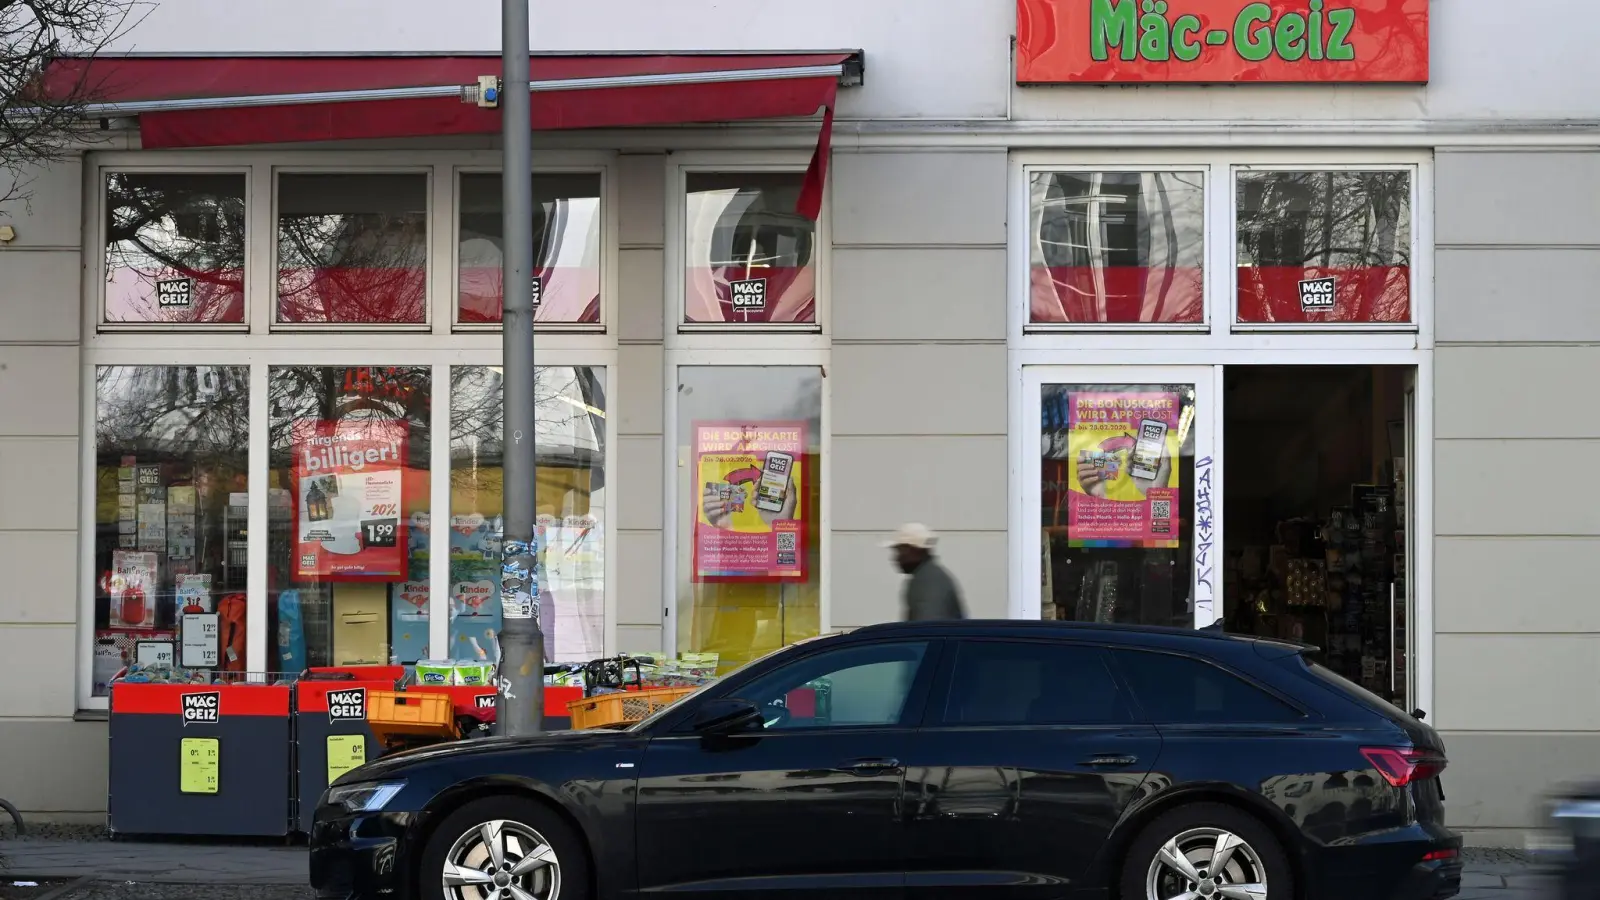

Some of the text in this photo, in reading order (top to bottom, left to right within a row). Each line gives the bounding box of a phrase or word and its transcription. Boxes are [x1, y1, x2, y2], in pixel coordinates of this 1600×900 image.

[1090, 0, 1356, 62] Mäc-Geiz
[160, 281, 189, 293] MÄC
[734, 282, 763, 294] MÄC
[1302, 282, 1333, 293] MÄC
[160, 293, 189, 305] GEIZ
[734, 294, 763, 305] GEIZ
[1302, 294, 1333, 305] GEIZ
[1077, 400, 1173, 408] DIE BONUSKARTE
[1076, 410, 1107, 419] WIRD
[306, 431, 362, 447] nirgends
[702, 432, 798, 440] DIE BONUSKARTE
[702, 442, 732, 451] WIRD
[304, 441, 399, 472] billiger!
[368, 524, 394, 542] 1.99
[184, 695, 217, 708] MÄC
[330, 692, 362, 705] MÄC
[184, 708, 216, 721] GEIZ
[330, 704, 362, 717] GEIZ
